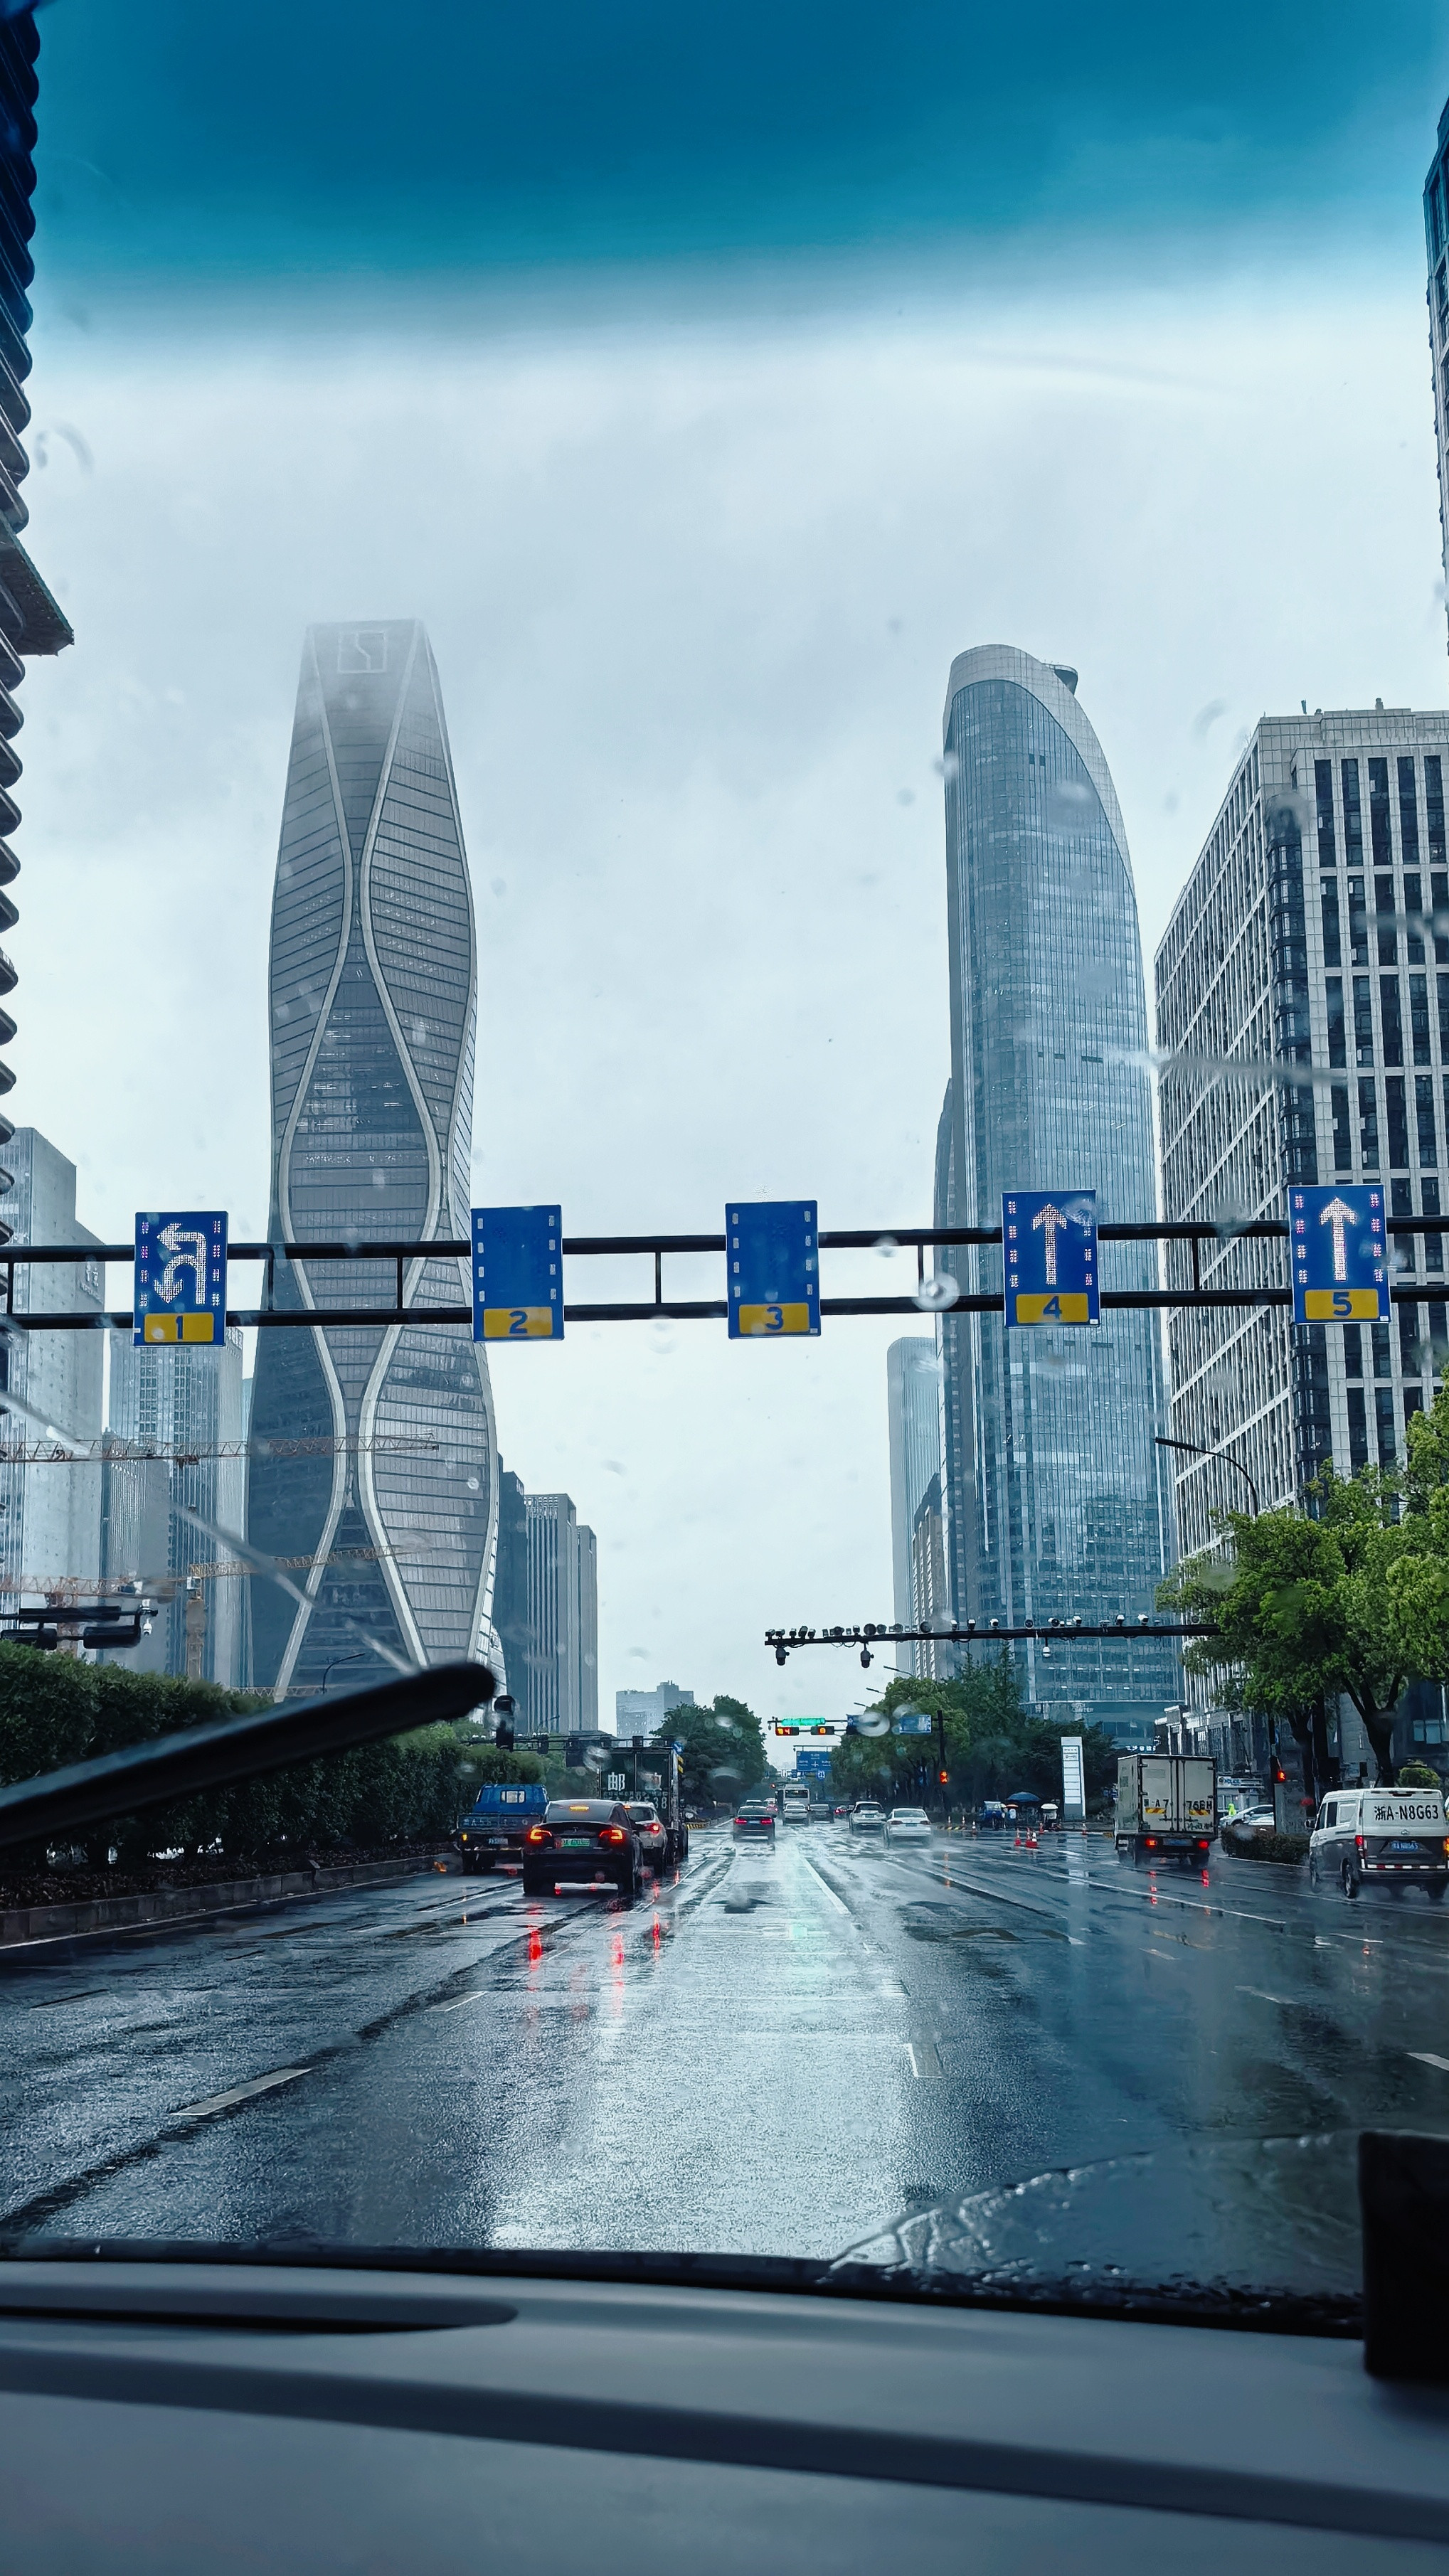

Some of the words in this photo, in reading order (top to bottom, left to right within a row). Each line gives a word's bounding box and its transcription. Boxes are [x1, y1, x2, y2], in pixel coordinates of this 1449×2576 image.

[1042, 1294, 1062, 1319] 4
[1332, 1291, 1353, 1316] 5
[175, 1315, 184, 1340] 1
[509, 1310, 529, 1335] 2
[764, 1306, 785, 1331] 3
